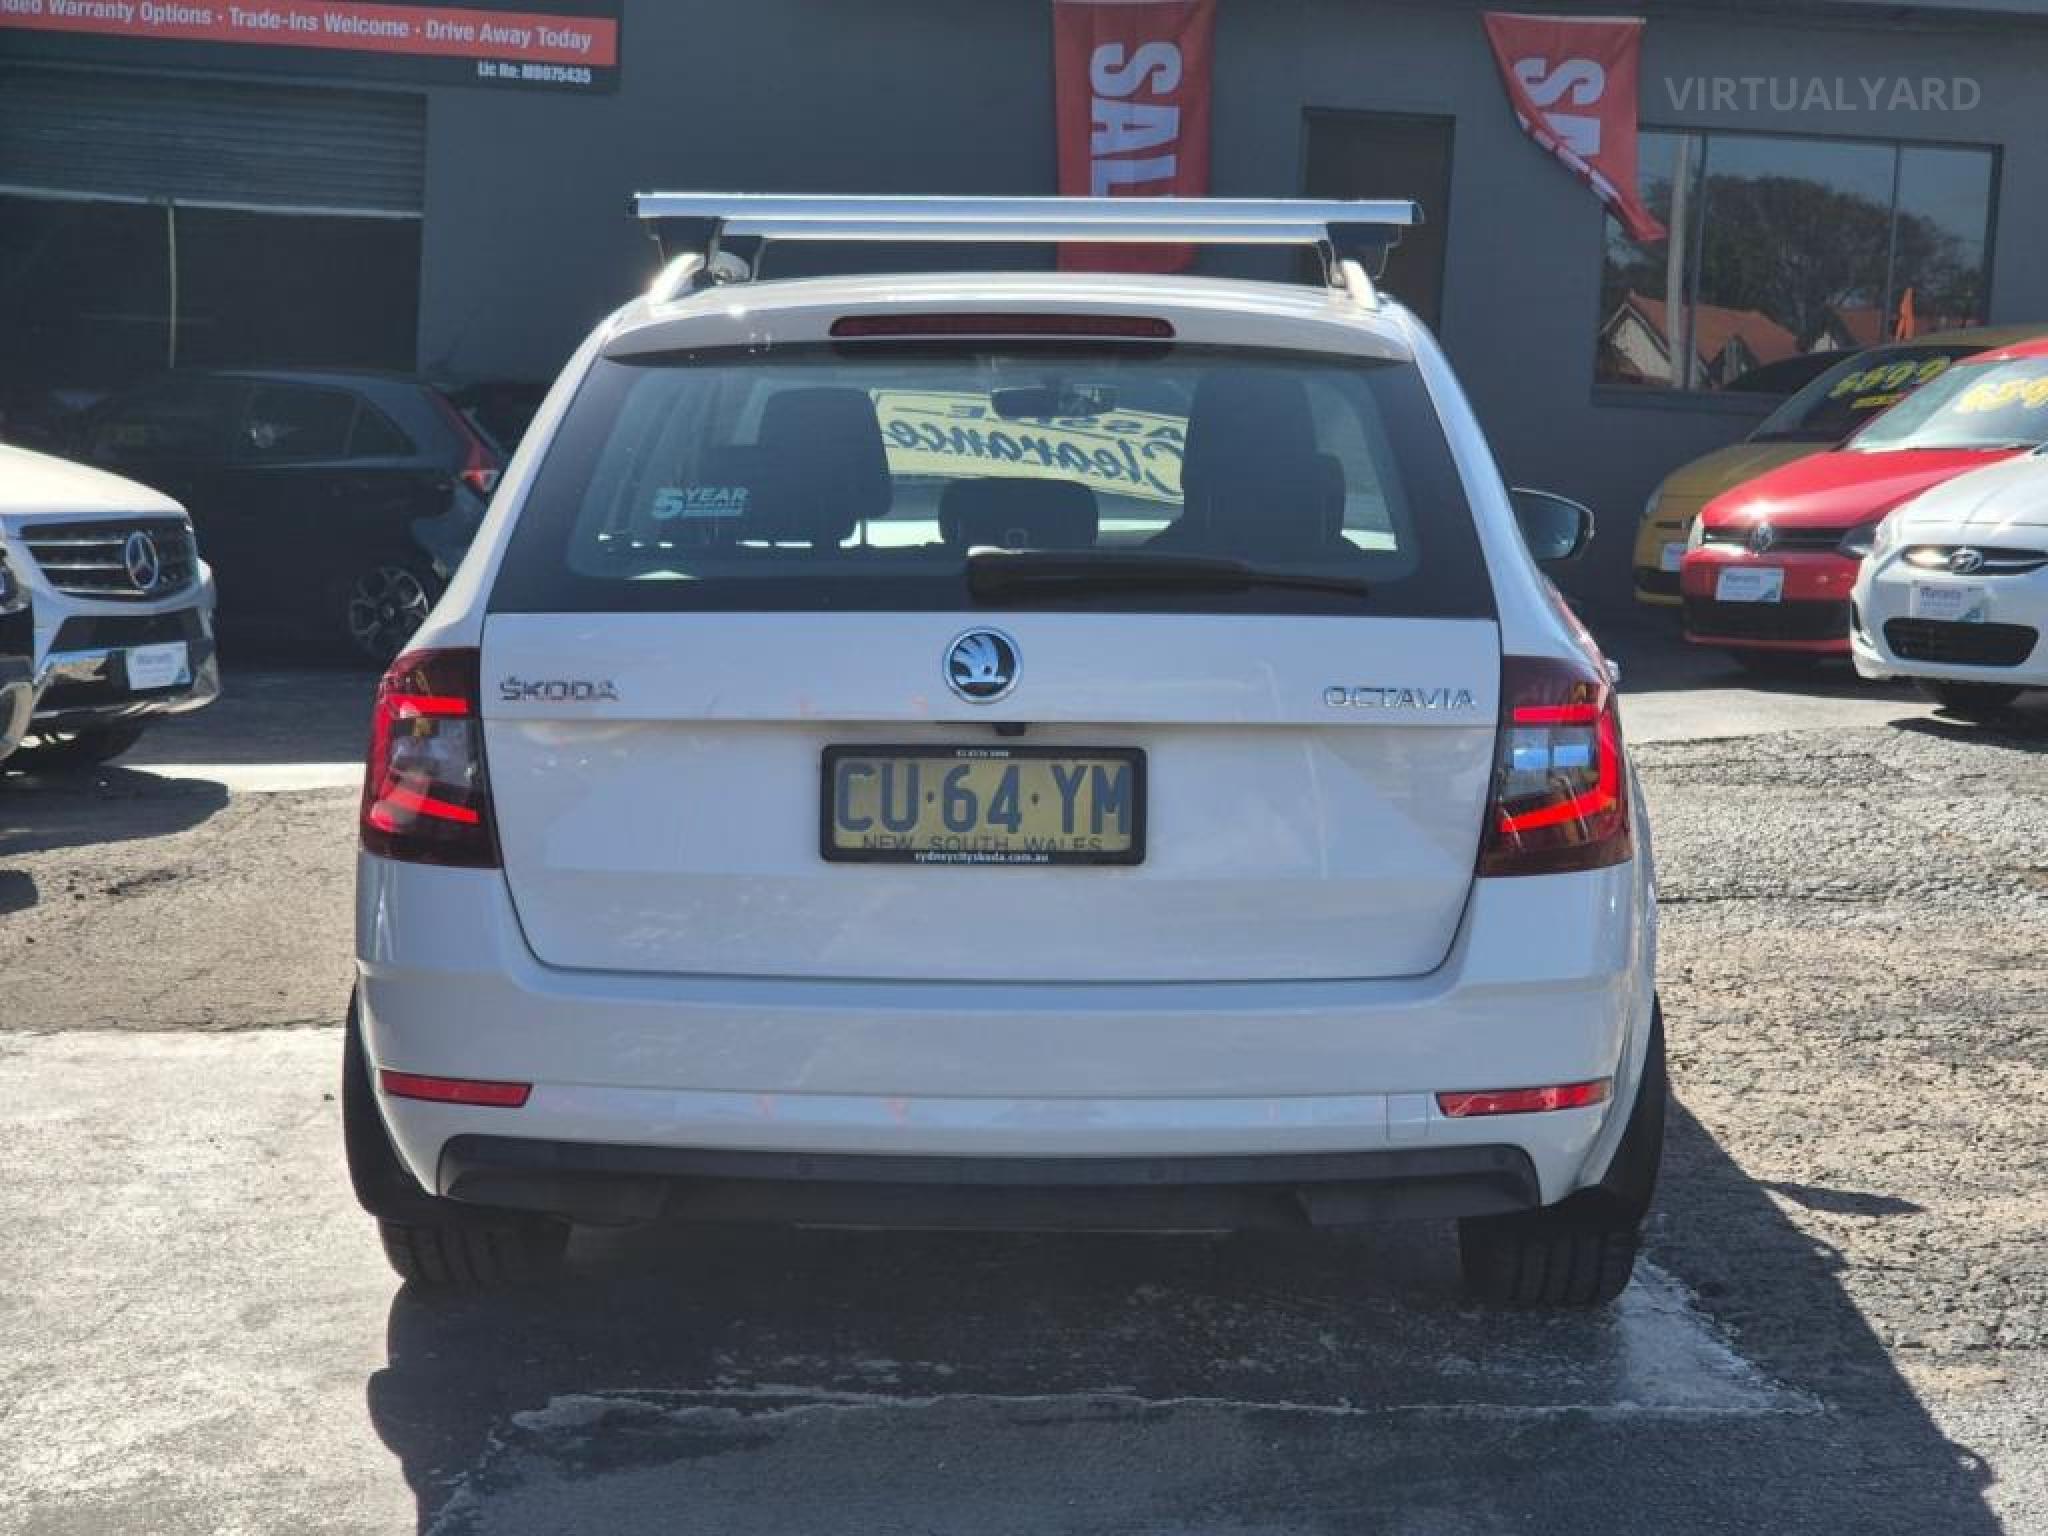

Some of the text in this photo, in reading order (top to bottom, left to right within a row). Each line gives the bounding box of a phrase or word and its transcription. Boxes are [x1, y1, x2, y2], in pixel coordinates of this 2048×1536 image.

[50, 0, 135, 23] Warranty
[141, 2, 212, 25] Options
[229, 7, 319, 31] Trade-Ins
[324, 12, 409, 38] Welcome
[425, 19, 474, 41] Drive
[480, 23, 531, 49] Away
[535, 26, 592, 54] Today
[1089, 41, 1183, 198] SAL
[686, 487, 749, 507] YEAR
[1323, 686, 1474, 709] OCTAVIA
[864, 833, 1104, 849] NEW SOUTH WALES
